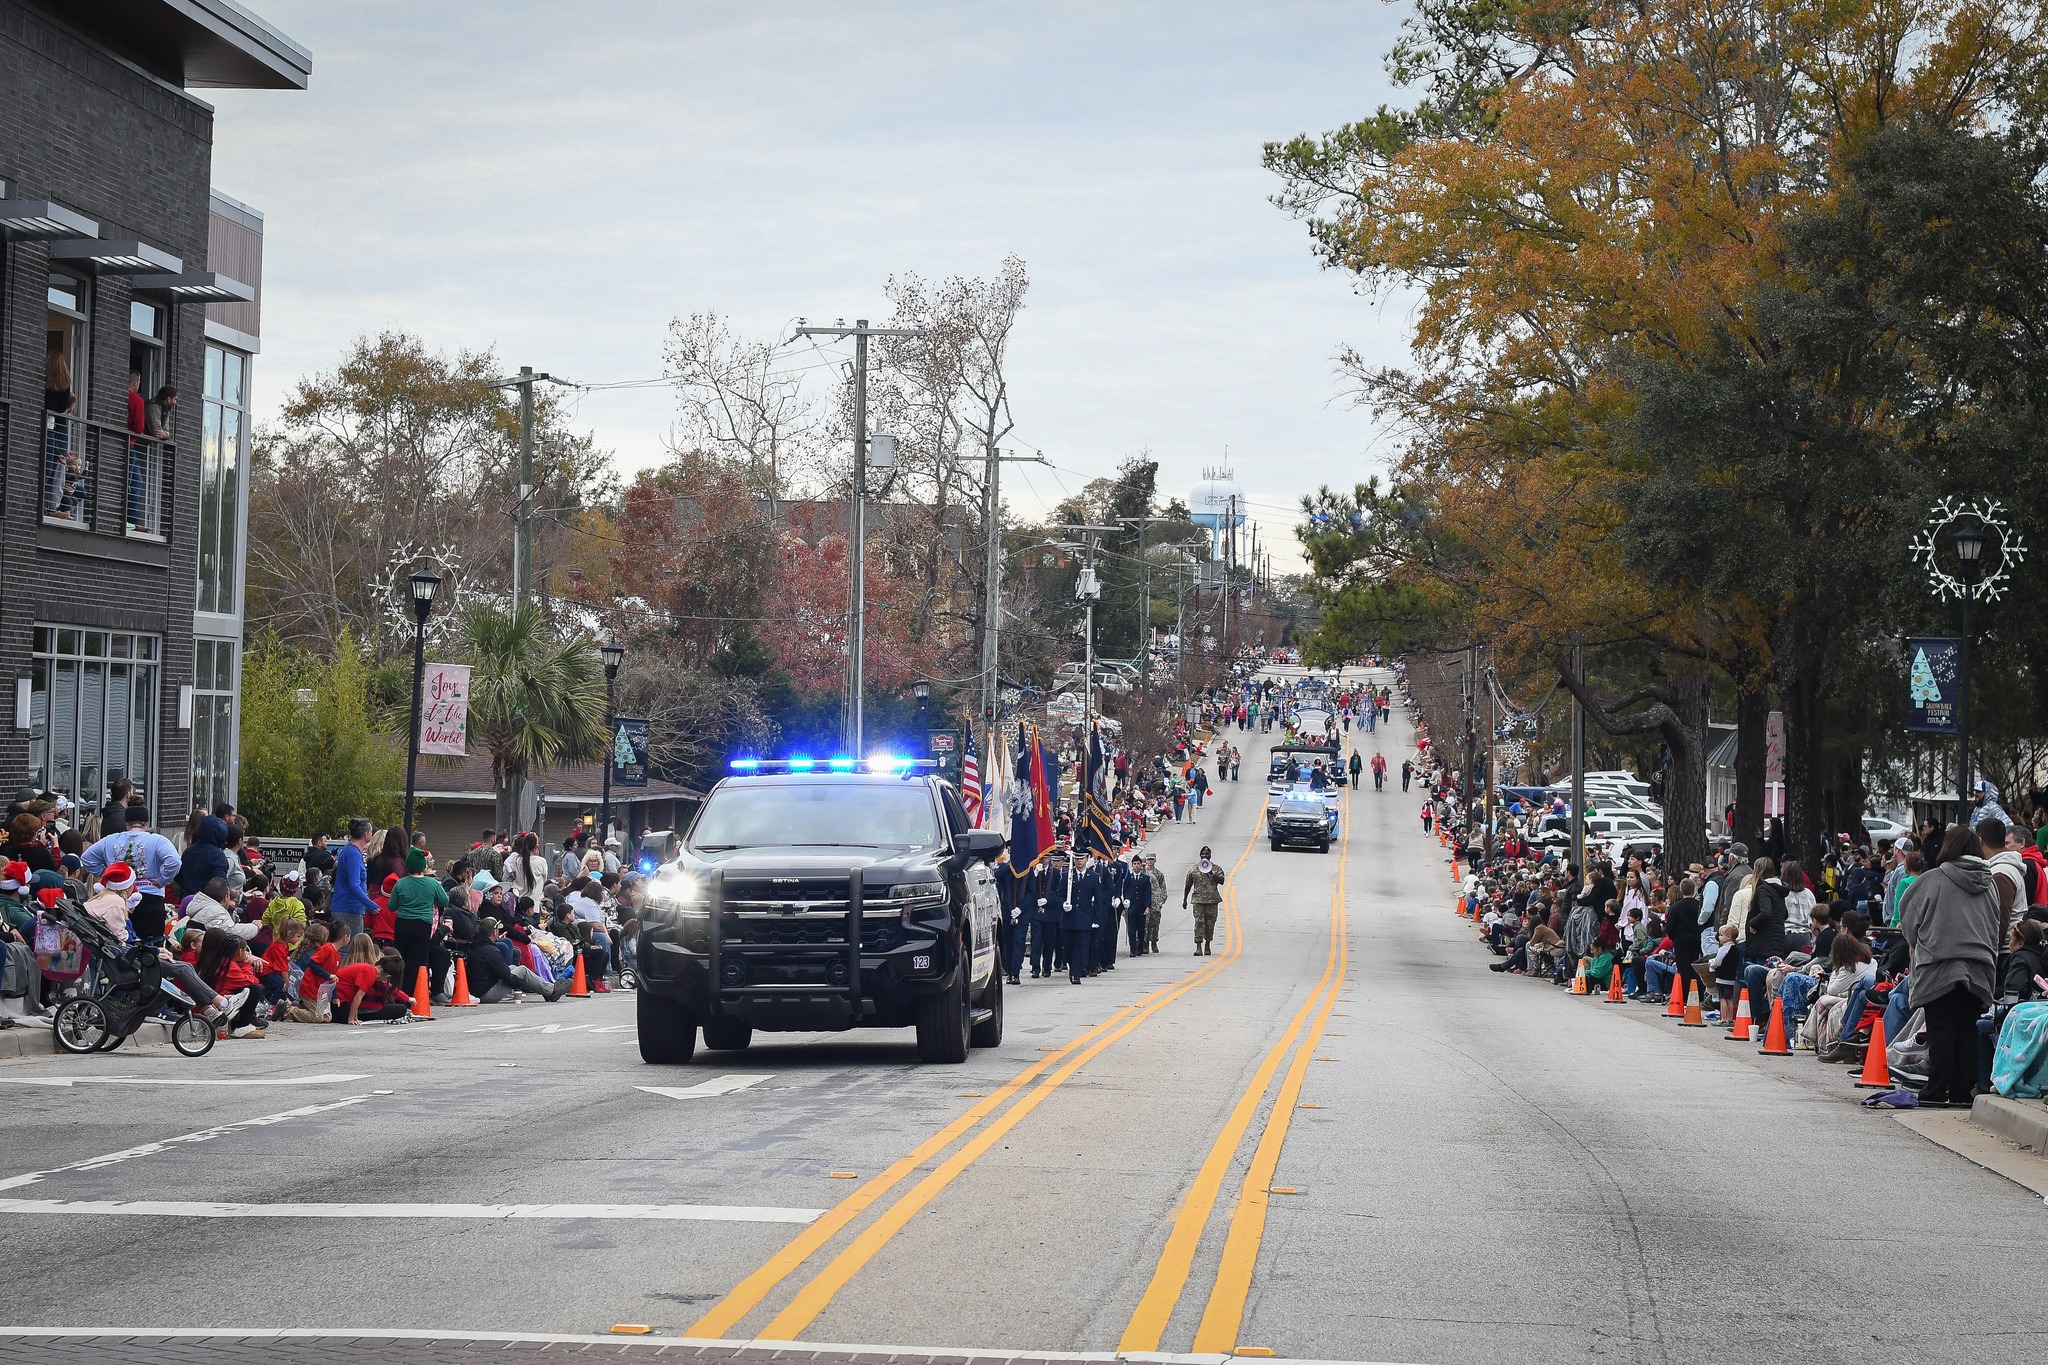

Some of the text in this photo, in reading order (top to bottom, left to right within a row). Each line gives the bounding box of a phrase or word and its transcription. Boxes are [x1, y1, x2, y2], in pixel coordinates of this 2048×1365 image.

[431, 672, 459, 700] Joy
[428, 703, 463, 722] to the
[425, 726, 463, 744] World
[286, 849, 302, 857] Otto
[913, 955, 930, 969] 123
